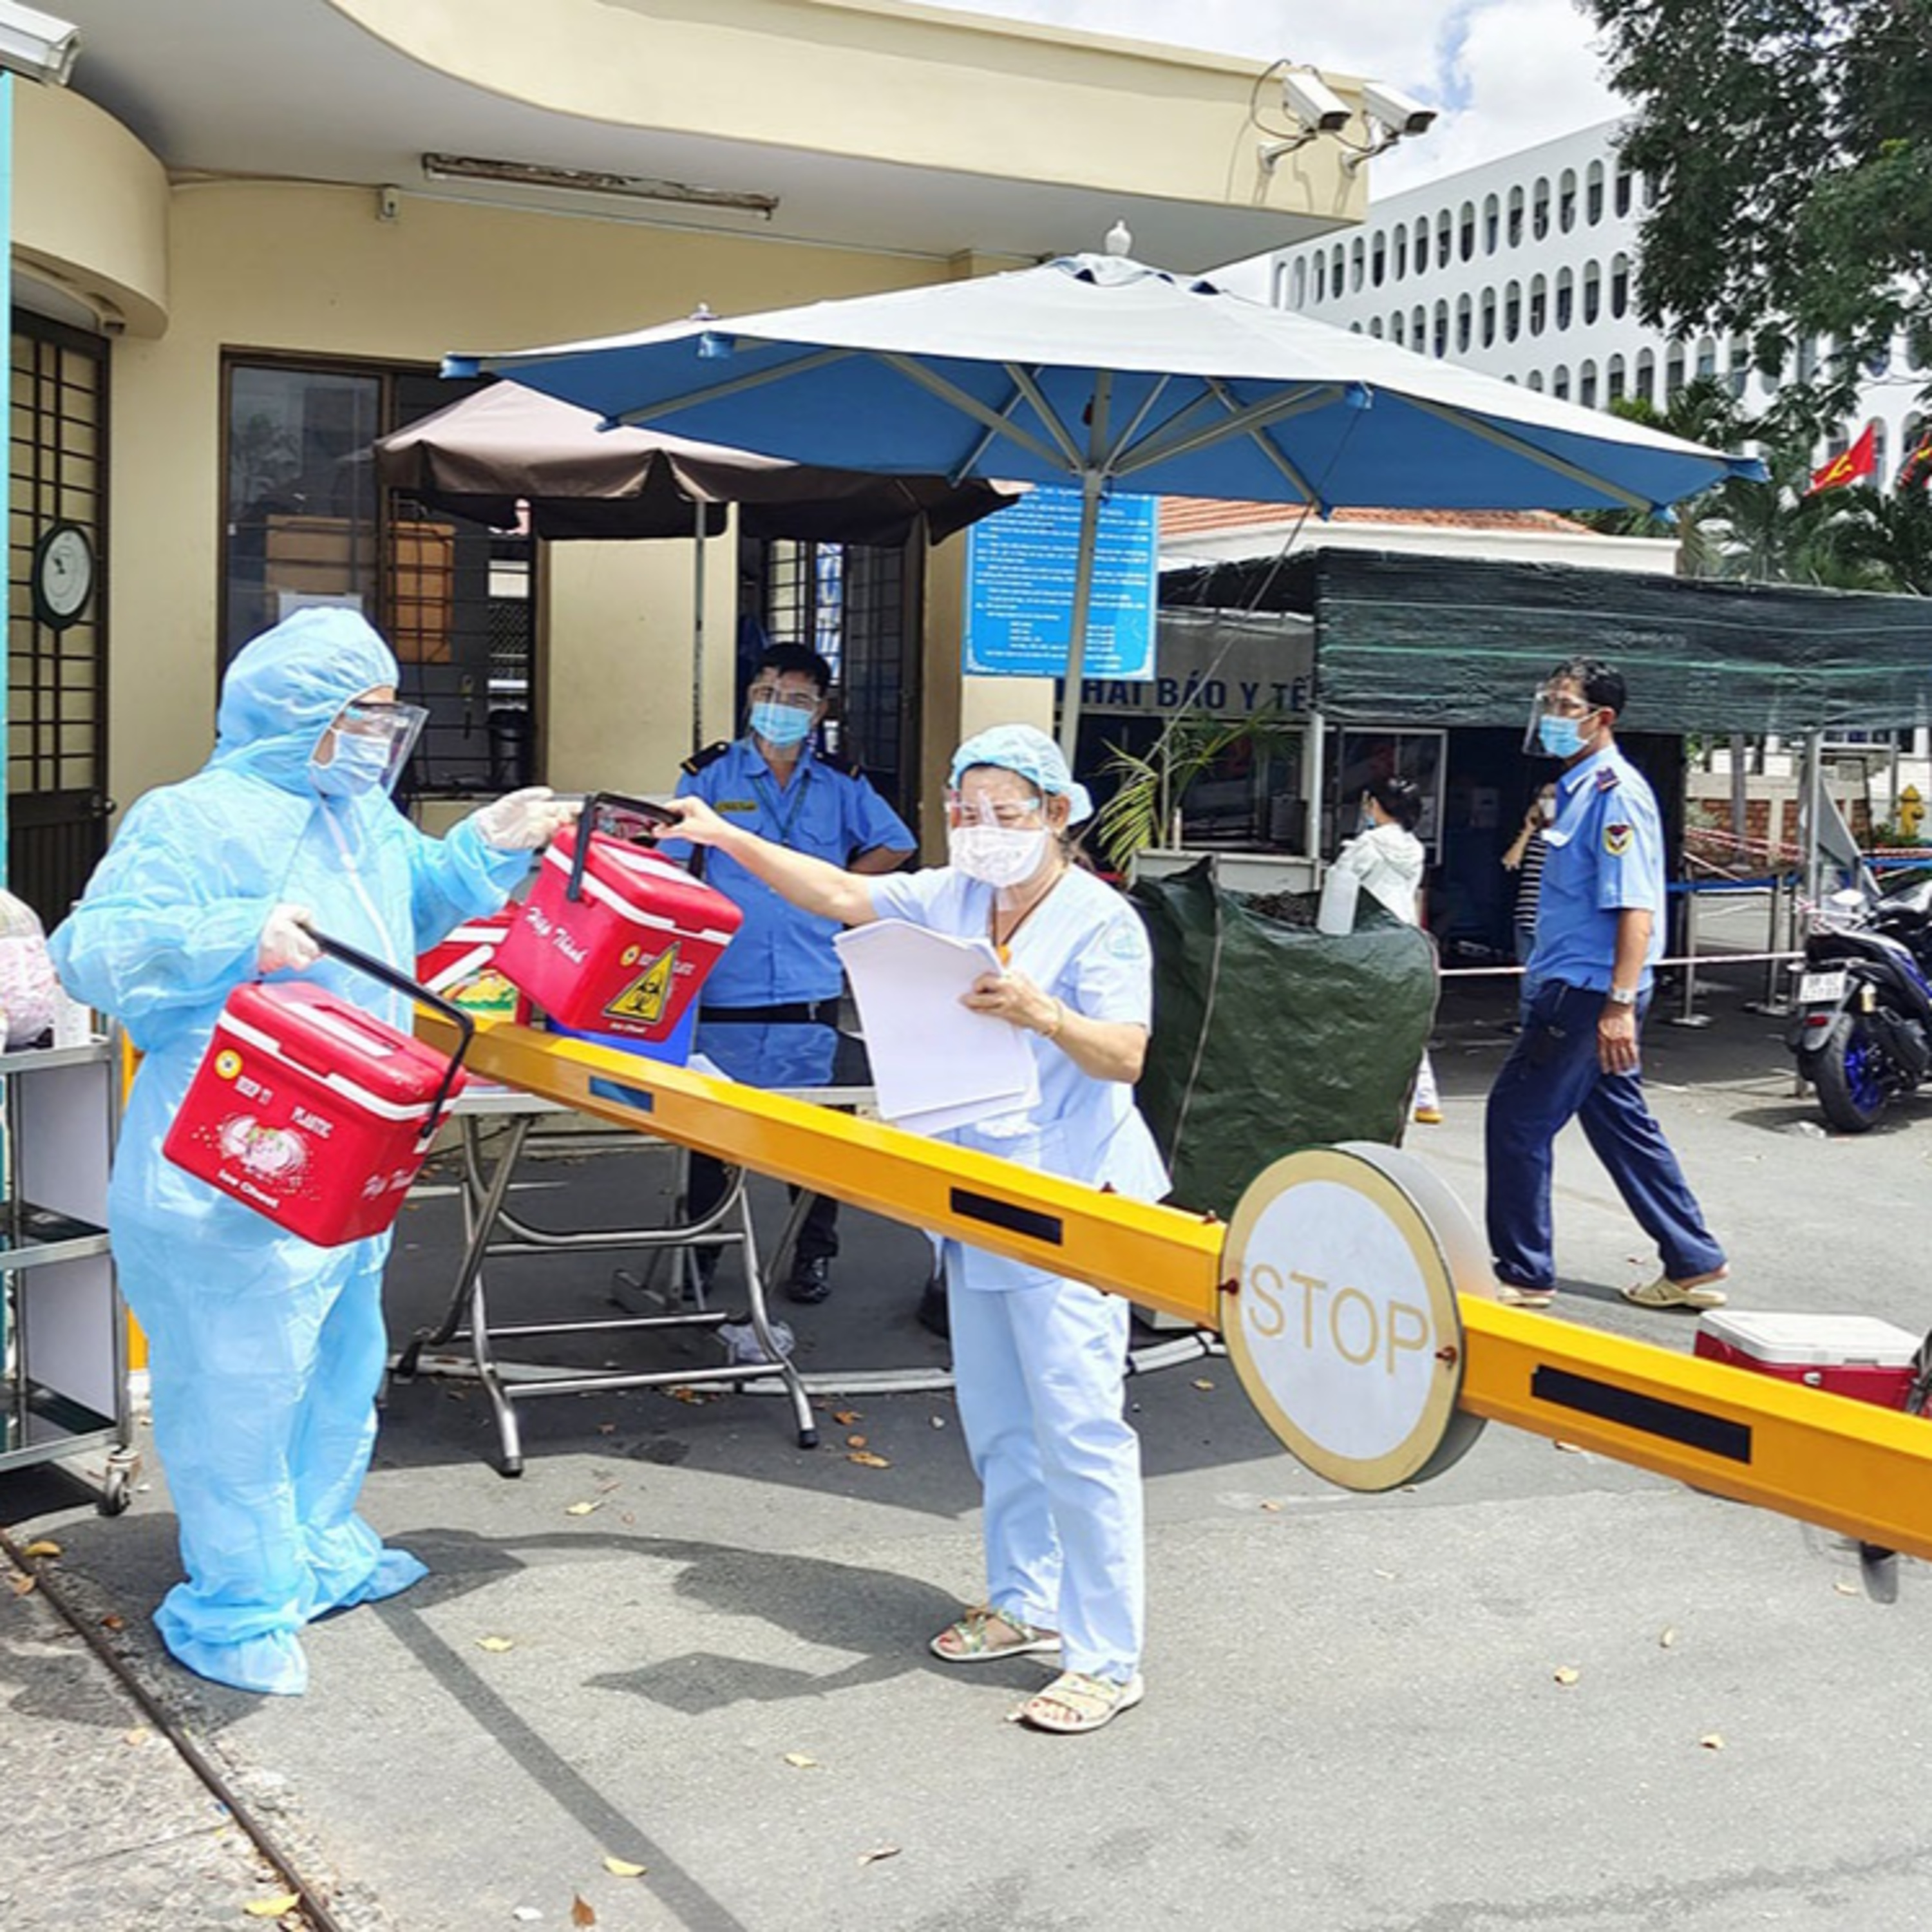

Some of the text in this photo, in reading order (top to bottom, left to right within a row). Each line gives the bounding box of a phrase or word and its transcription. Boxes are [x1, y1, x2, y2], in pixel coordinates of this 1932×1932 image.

[1157, 669, 1226, 709] BÁO
[1240, 682, 1260, 711] Y
[1271, 676, 1311, 712] TẾ
[1248, 1264, 1429, 1376] STOP
